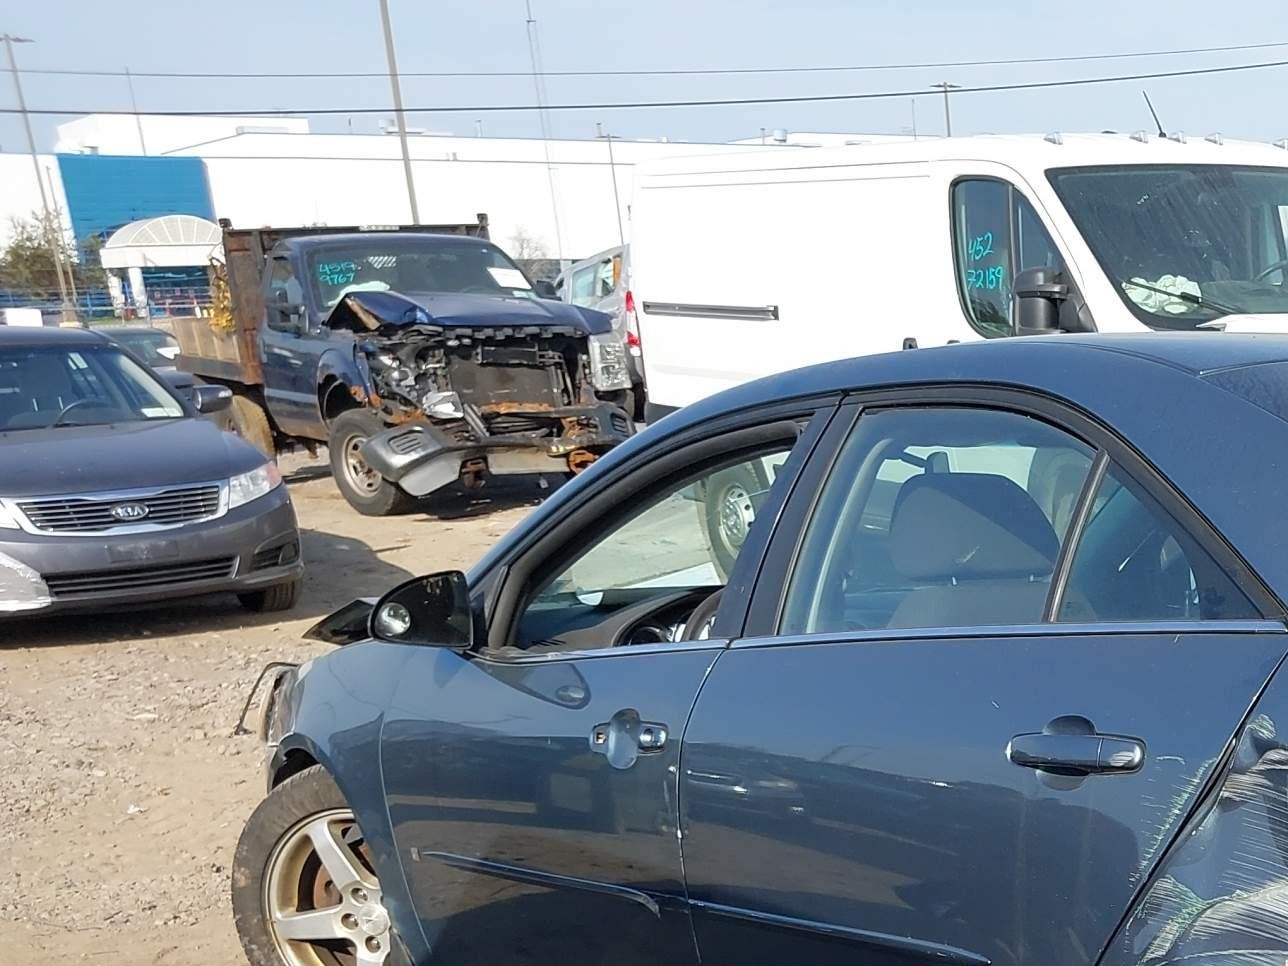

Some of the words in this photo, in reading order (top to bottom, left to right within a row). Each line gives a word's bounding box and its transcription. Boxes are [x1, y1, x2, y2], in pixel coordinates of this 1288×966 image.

[968, 232, 993, 261] 452
[319, 273, 355, 286] 9767
[967, 266, 1003, 291] 72159
[116, 506, 144, 517] KIA
